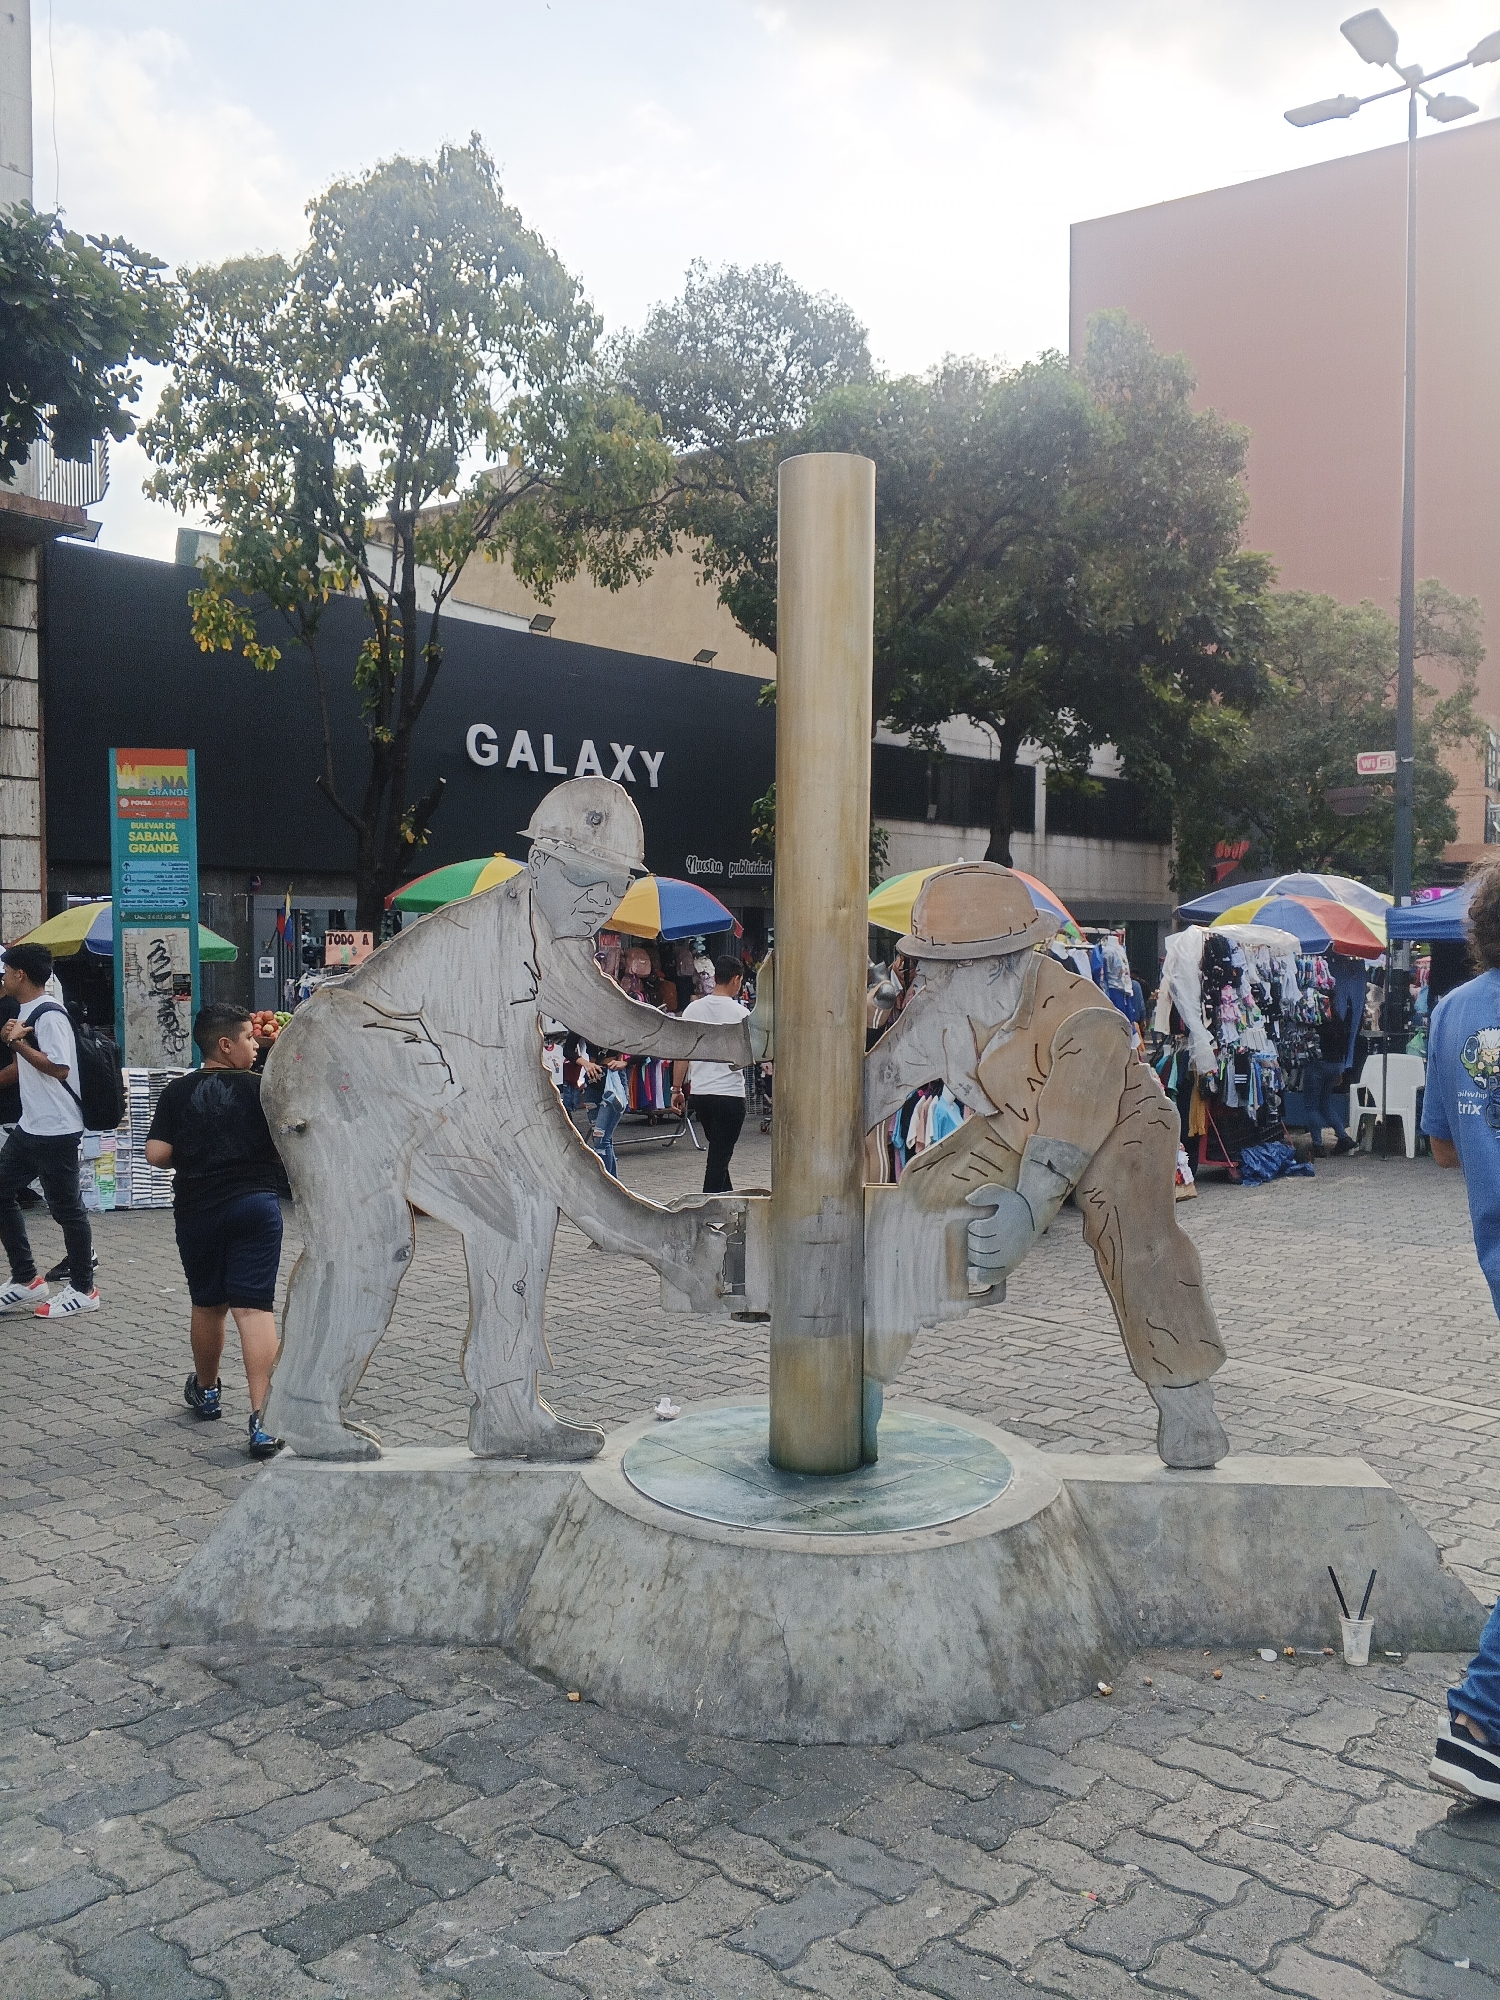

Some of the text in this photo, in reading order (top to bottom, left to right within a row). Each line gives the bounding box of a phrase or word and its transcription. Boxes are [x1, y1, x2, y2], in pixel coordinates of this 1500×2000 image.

[466, 723, 665, 788] GALAXY
[148, 788, 189, 796] GRANDE
[131, 822, 176, 830] BULEVAR DE
[128, 831, 178, 842] SABANA
[128, 843, 179, 853] GRANDE
[686, 855, 772, 878] Nuestra publicidad
[327, 933, 369, 945] TODO A
